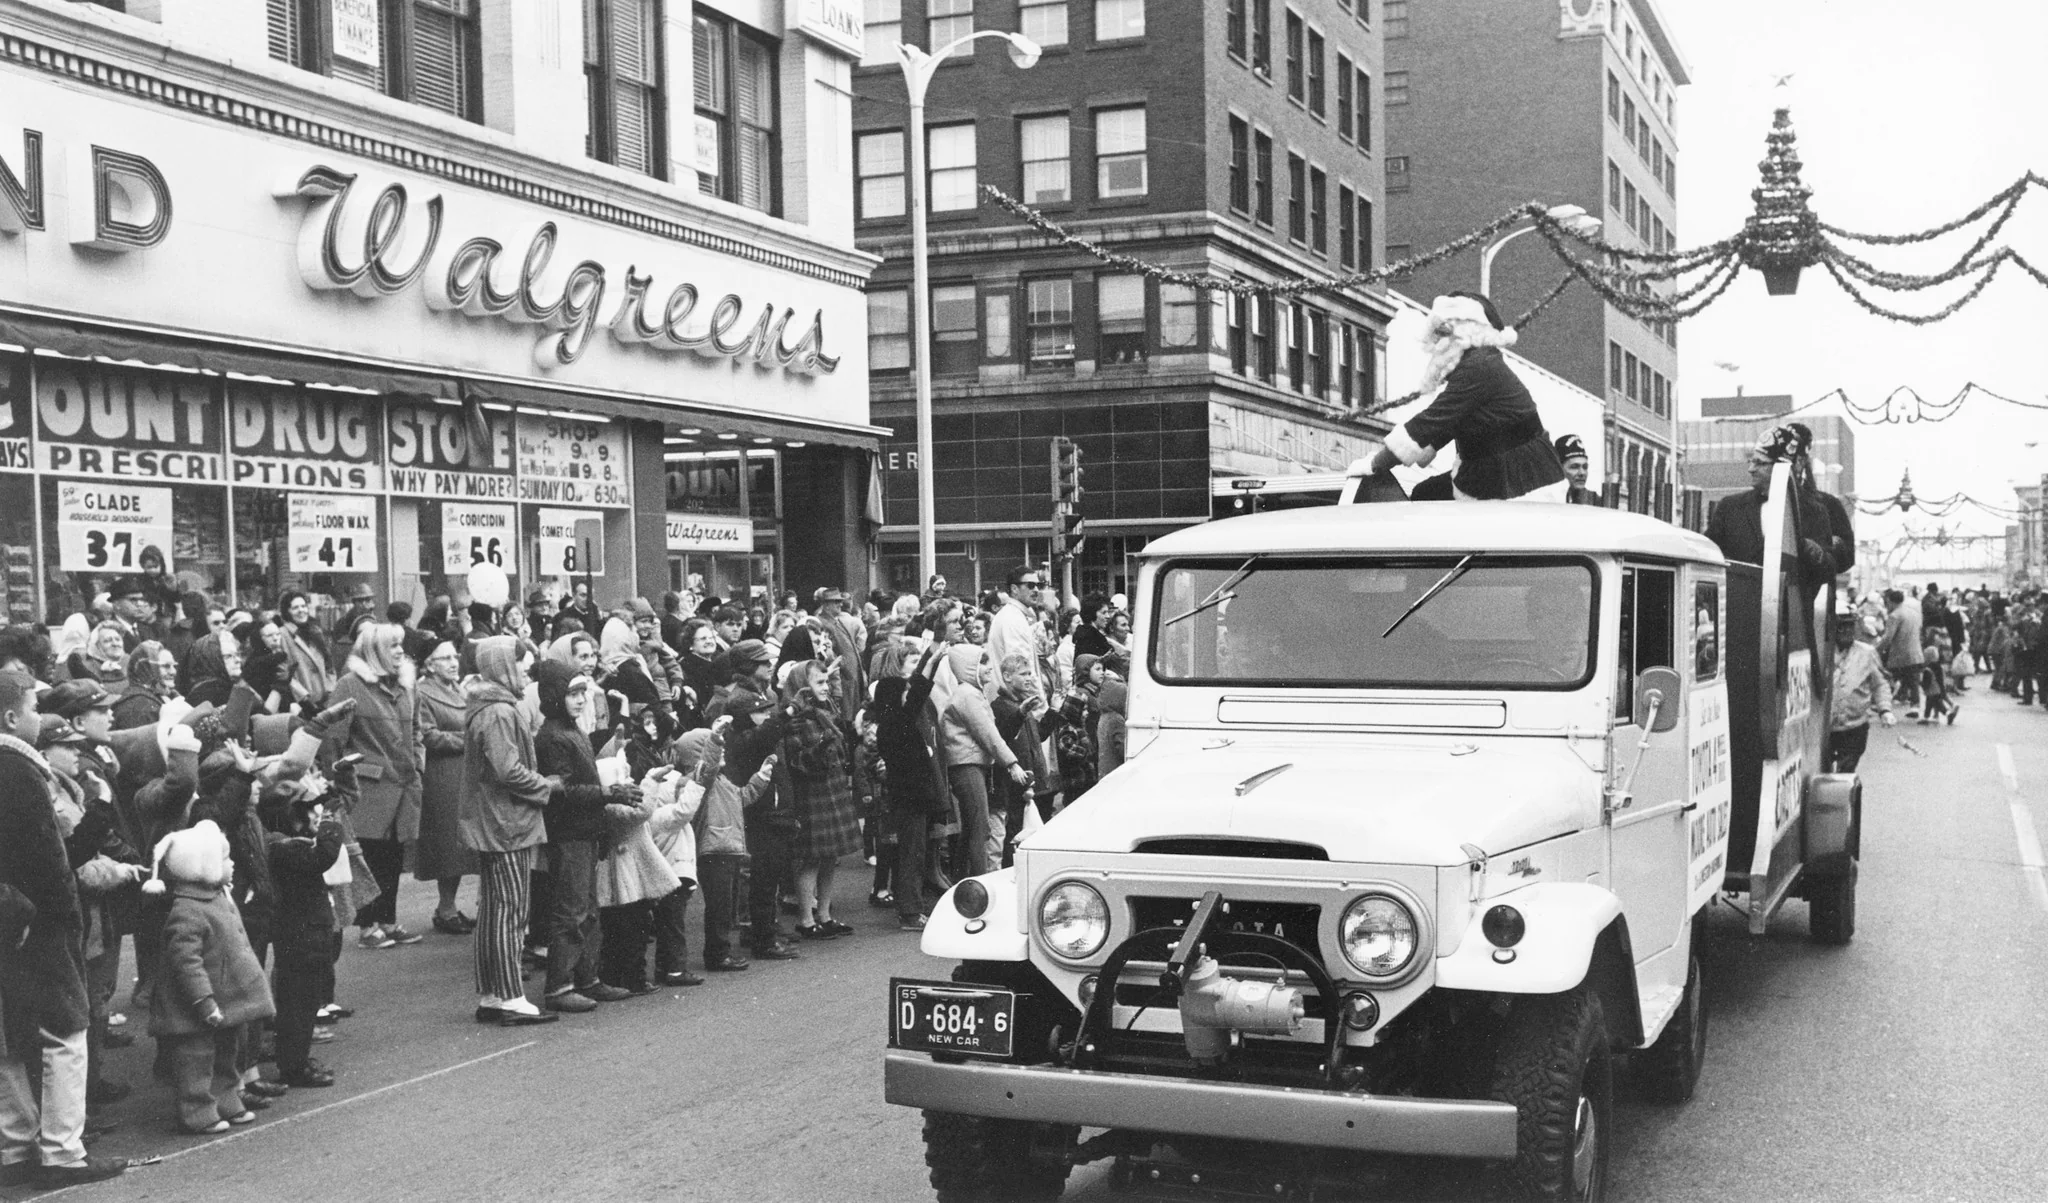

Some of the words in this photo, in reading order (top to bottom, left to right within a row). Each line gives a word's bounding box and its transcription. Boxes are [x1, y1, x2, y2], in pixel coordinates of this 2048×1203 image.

[822, 0, 861, 40] LOANS
[292, 163, 842, 377] Walgreens
[234, 395, 368, 459] DRUG
[391, 407, 511, 469] STOE
[547, 422, 599, 442] SHOP
[571, 442, 582, 460] 9
[598, 445, 609, 462] 9
[391, 469, 427, 493] WHY
[435, 472, 461, 495] PAY
[466, 474, 513, 498] MORE?
[583, 464, 592, 480] 9
[603, 464, 612, 482] 8
[520, 480, 561, 500] SUNDAY
[562, 482, 576, 502] 10
[84, 493, 141, 512] GLADE
[316, 514, 345, 529] FLOOR
[346, 515, 370, 529] WAX
[460, 513, 506, 528] CORICIDIN
[541, 526, 564, 538] COMET
[667, 522, 739, 545] Walgreens
[86, 530, 132, 568] 37
[318, 537, 354, 568] 47
[470, 536, 503, 569] 56
[1173, 917, 1285, 938] TOTA
[901, 988, 918, 1000] 65
[928, 1034, 953, 1045] NEW
[956, 1036, 981, 1047] CAR
